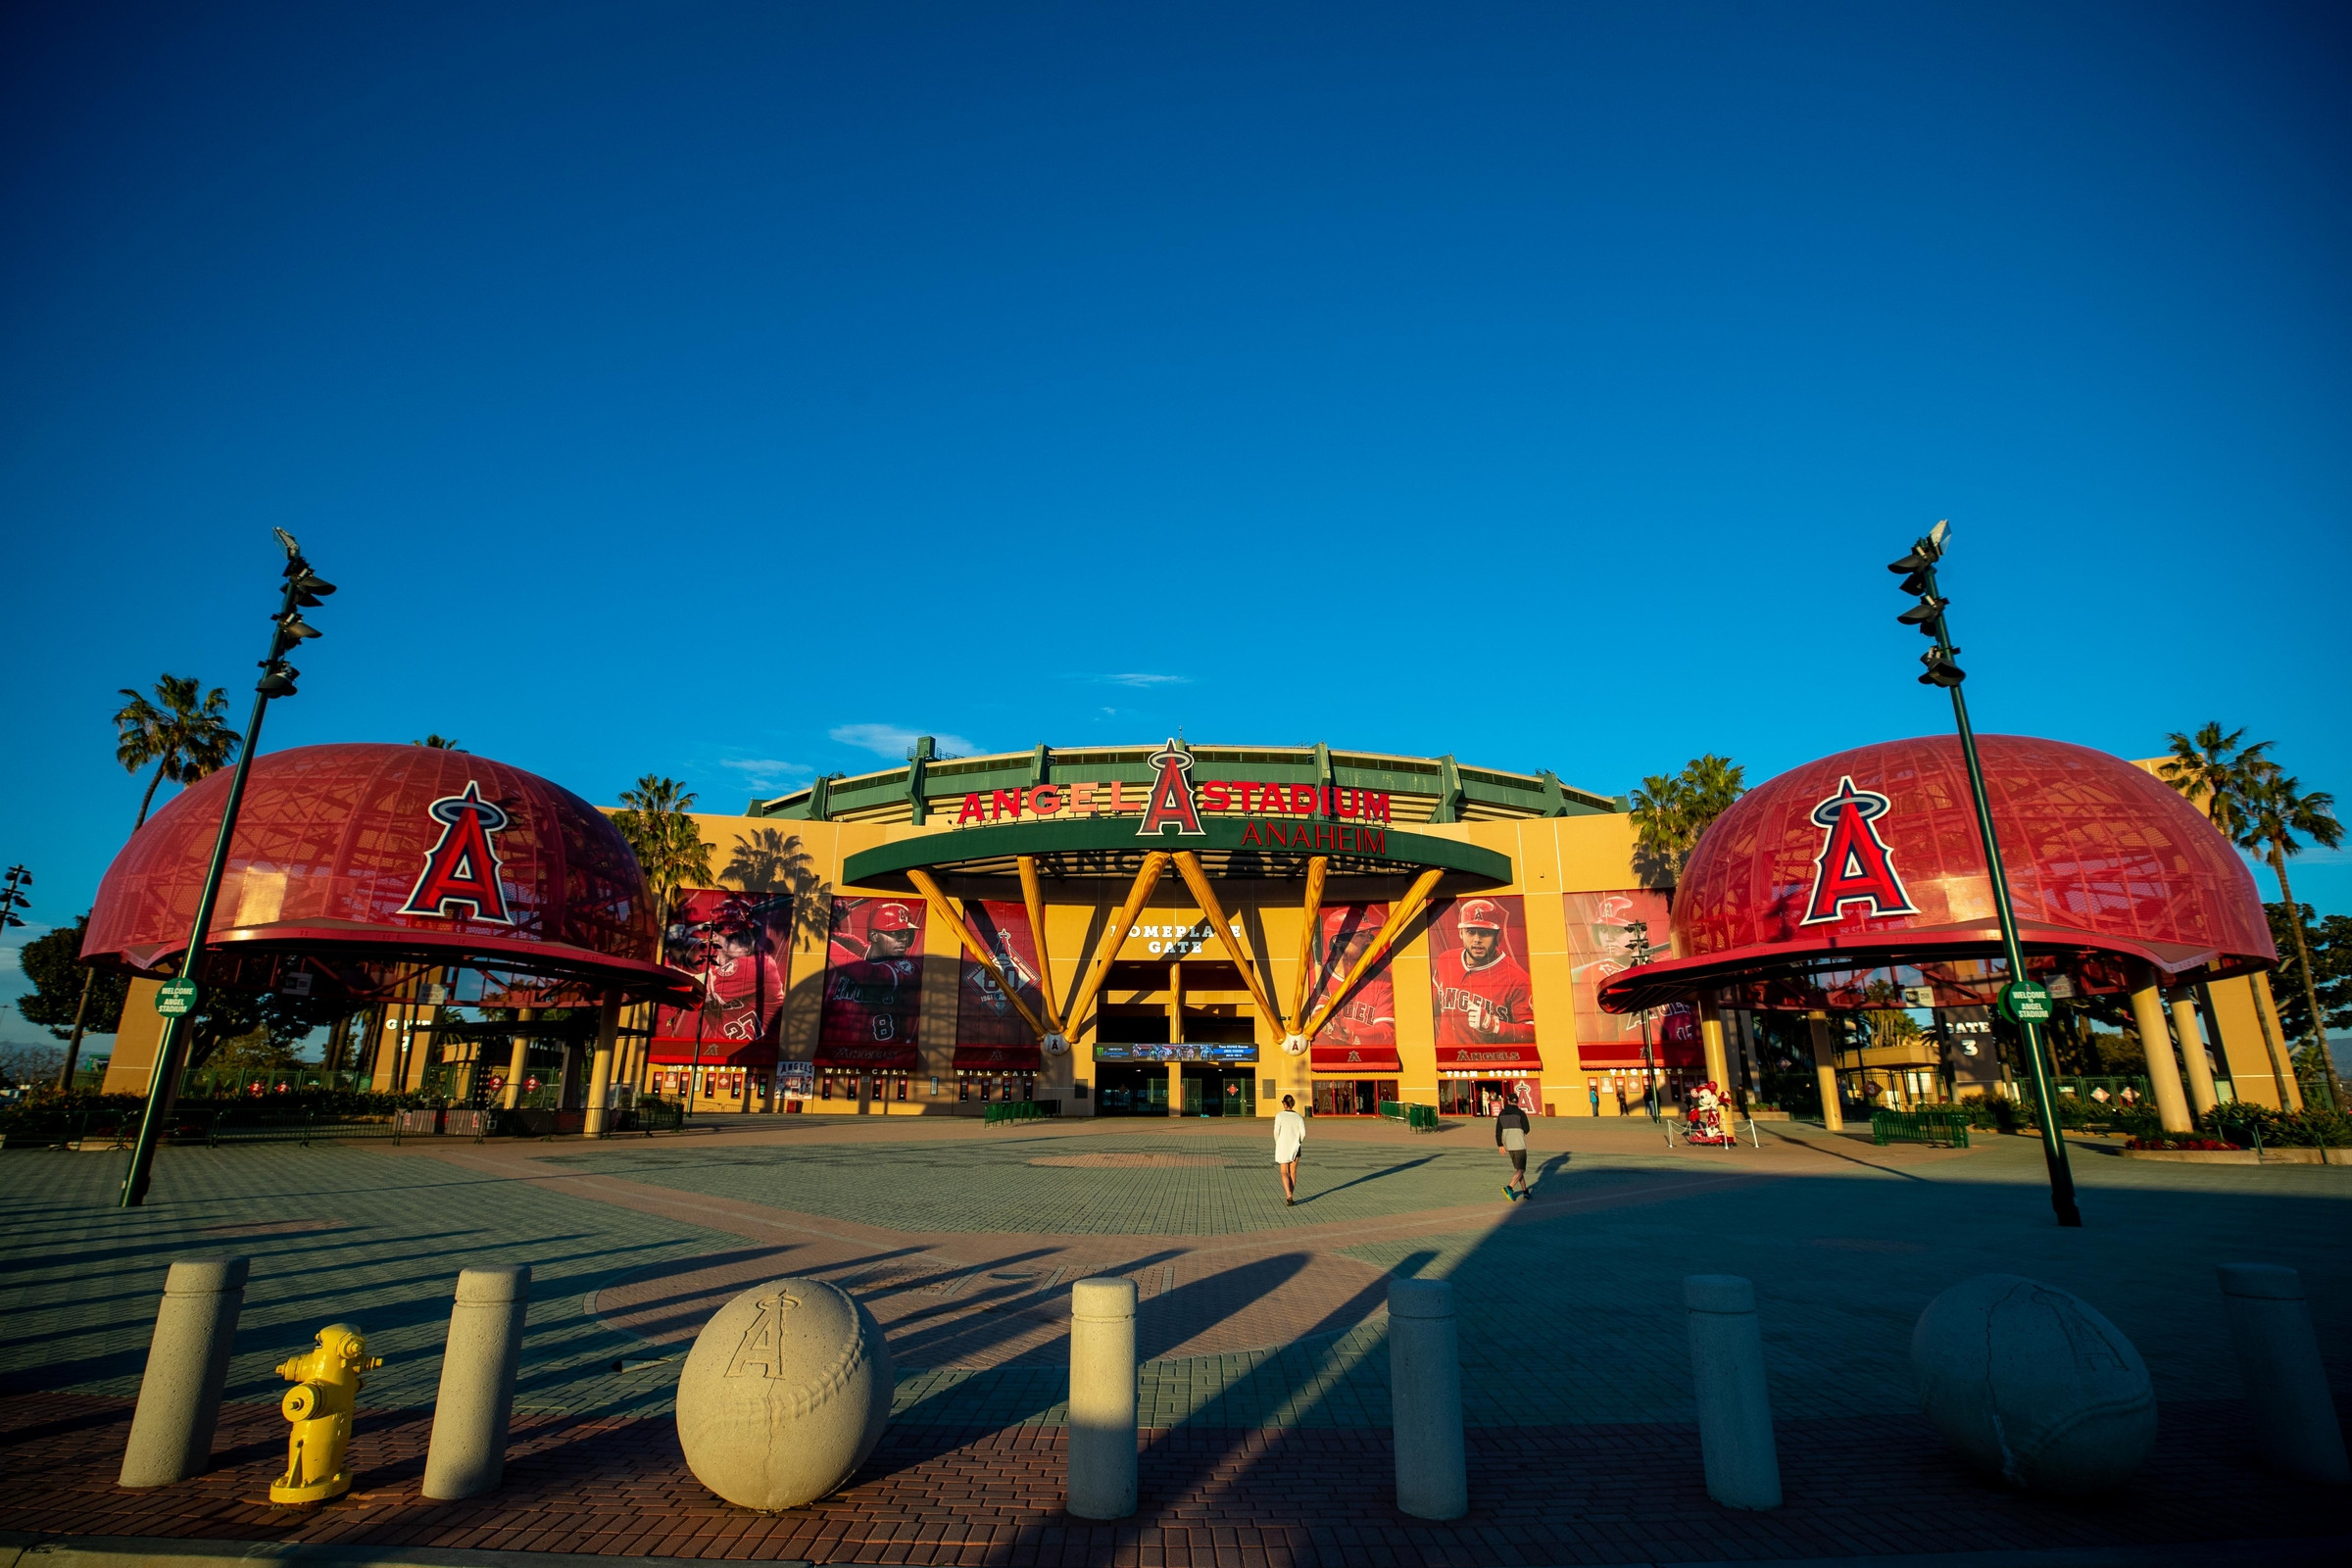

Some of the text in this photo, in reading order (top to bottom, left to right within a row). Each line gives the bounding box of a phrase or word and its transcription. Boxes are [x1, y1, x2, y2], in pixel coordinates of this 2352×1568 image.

[1136, 737, 1206, 836] A
[956, 779, 1392, 825] ANGEL STADIUM
[1242, 821, 1386, 856] ANAHEIM
[396, 779, 515, 926] A
[1799, 775, 1923, 926] A
[1110, 925, 1242, 938] OMEPLAE
[1148, 941, 1203, 954] GATE
[158, 1004, 188, 1013] STADIUM
[2018, 1009, 2050, 1018] STADIUM
[723, 1010, 764, 1041] 27
[872, 1012, 895, 1042] 8
[1456, 1049, 1521, 1061] ANGELS
[1961, 1039, 1979, 1056] 3
[677, 1064, 748, 1073] TICKETS
[780, 1062, 813, 1074] ANGELS
